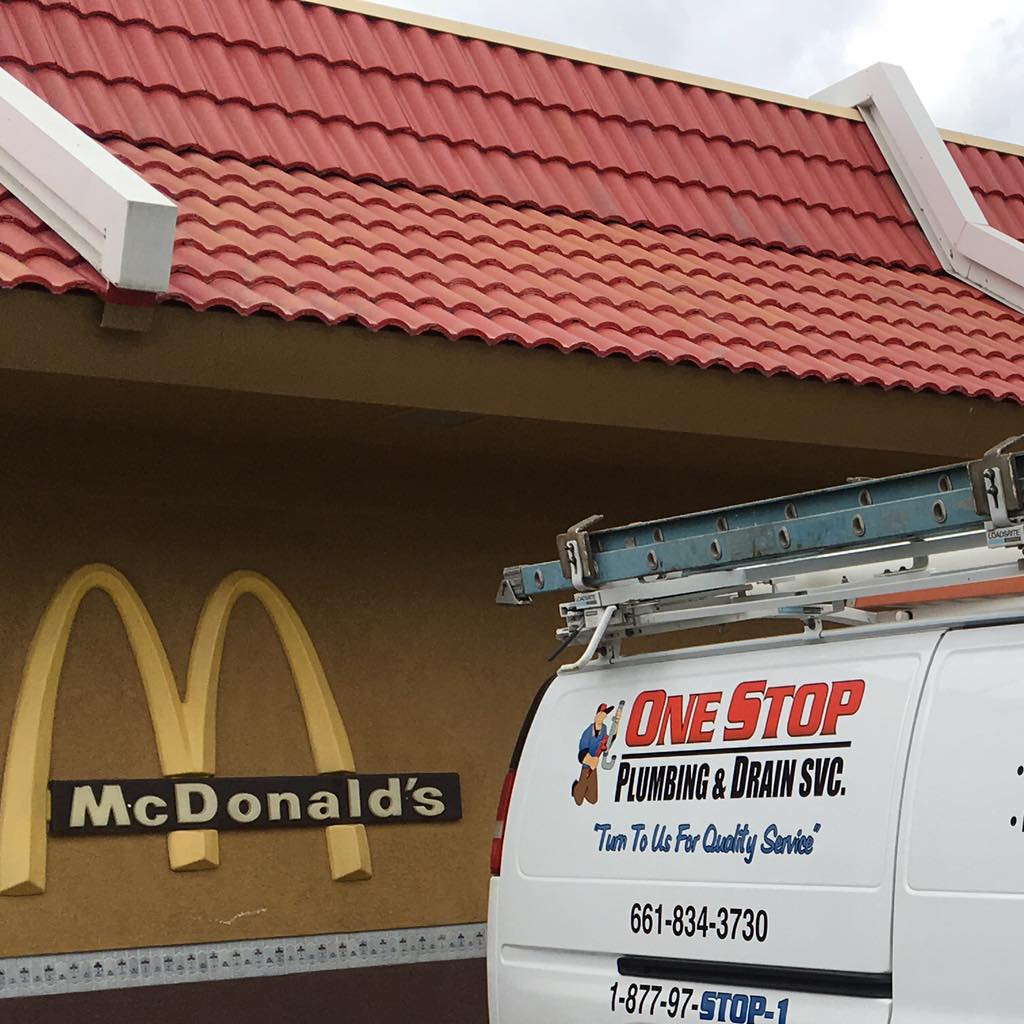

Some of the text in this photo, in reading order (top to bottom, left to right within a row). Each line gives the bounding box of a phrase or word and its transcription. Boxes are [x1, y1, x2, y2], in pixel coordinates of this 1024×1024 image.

[625, 679, 866, 747] ONE STOP
[614, 756, 846, 803] PLUMBING & DRAIN SVC.
[69, 778, 447, 829] McDonald's
[631, 824, 648, 852] To
[651, 824, 672, 852] Us
[674, 824, 700, 853] For
[702, 823, 758, 864] Quality
[630, 903, 769, 943] 661-834-3730
